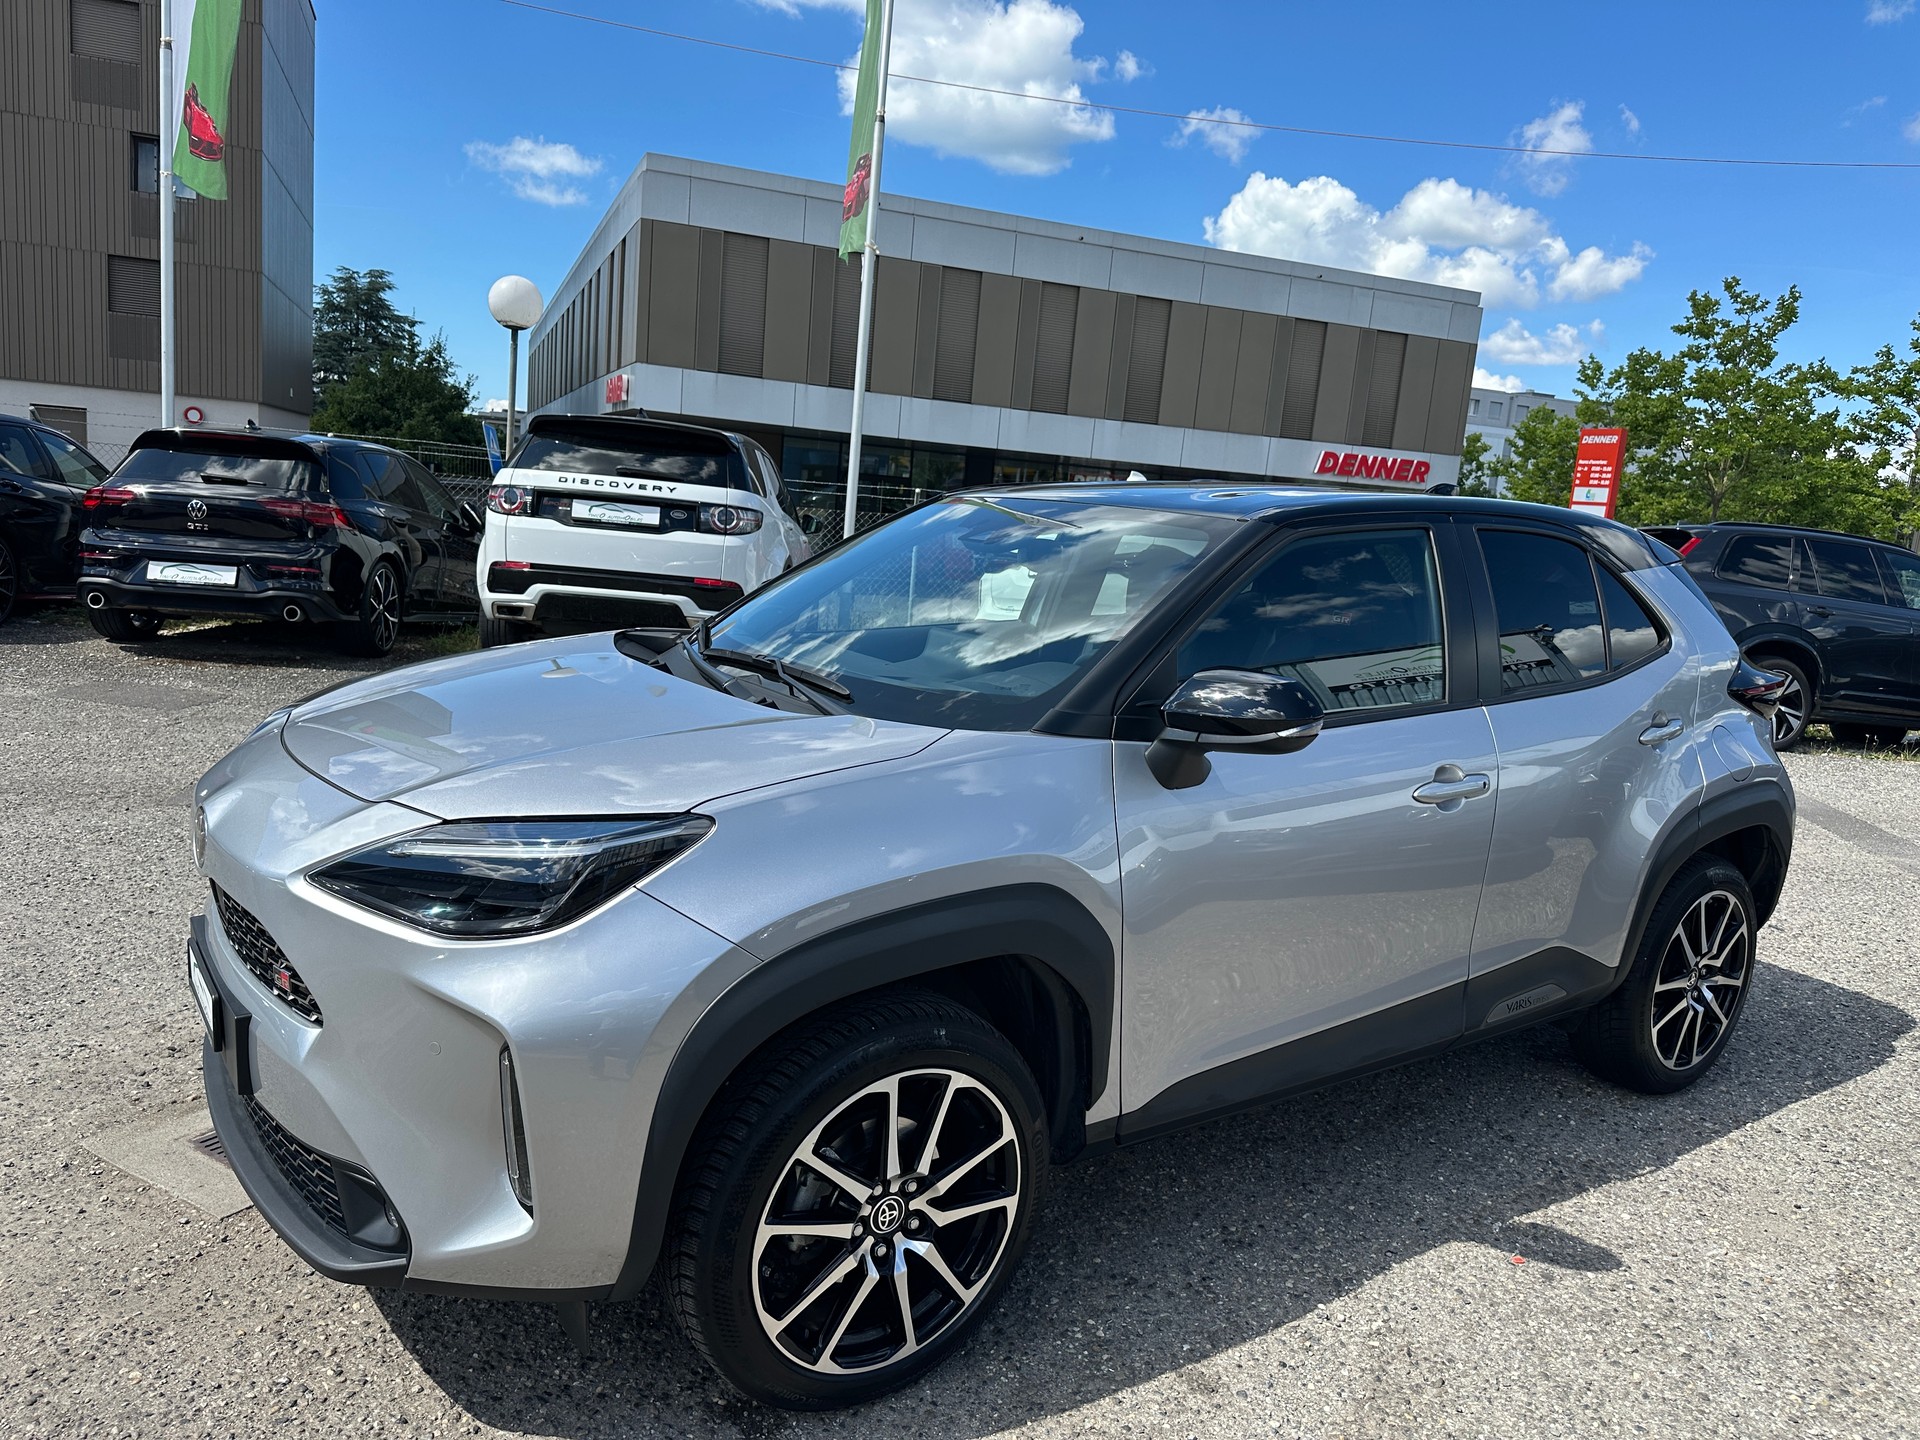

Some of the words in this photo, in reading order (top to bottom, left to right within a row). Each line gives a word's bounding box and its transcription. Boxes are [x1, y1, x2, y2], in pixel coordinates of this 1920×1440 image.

[1581, 435, 1618, 444] DENNER
[1314, 450, 1431, 483] DENNER
[558, 476, 678, 493] DISCOVERY
[187, 522, 209, 531] GTI
